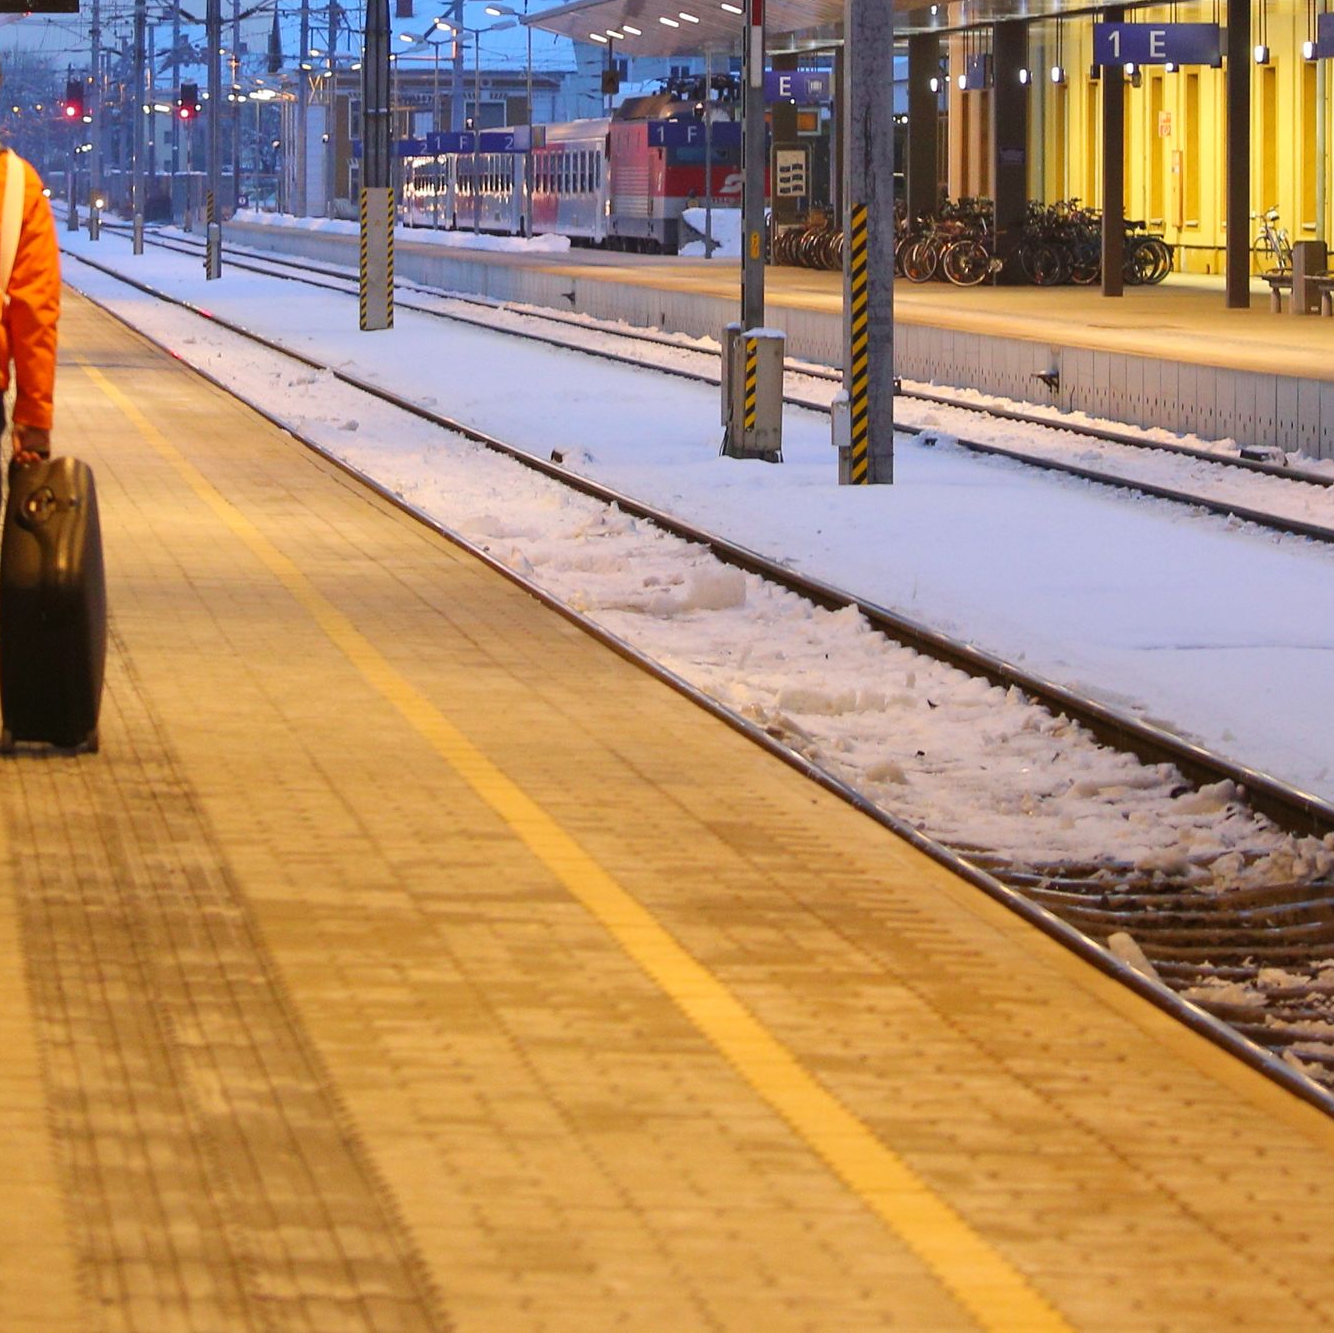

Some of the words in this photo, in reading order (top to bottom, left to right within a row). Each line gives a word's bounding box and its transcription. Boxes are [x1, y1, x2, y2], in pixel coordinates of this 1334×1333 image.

[1109, 30, 1120, 58] 1
[1150, 30, 1166, 58] E
[779, 76, 792, 97] E
[434, 136, 441, 150] 1
[459, 136, 468, 150] F
[505, 136, 515, 150] 2
[657, 127, 665, 143] 1
[688, 126, 698, 143] F
